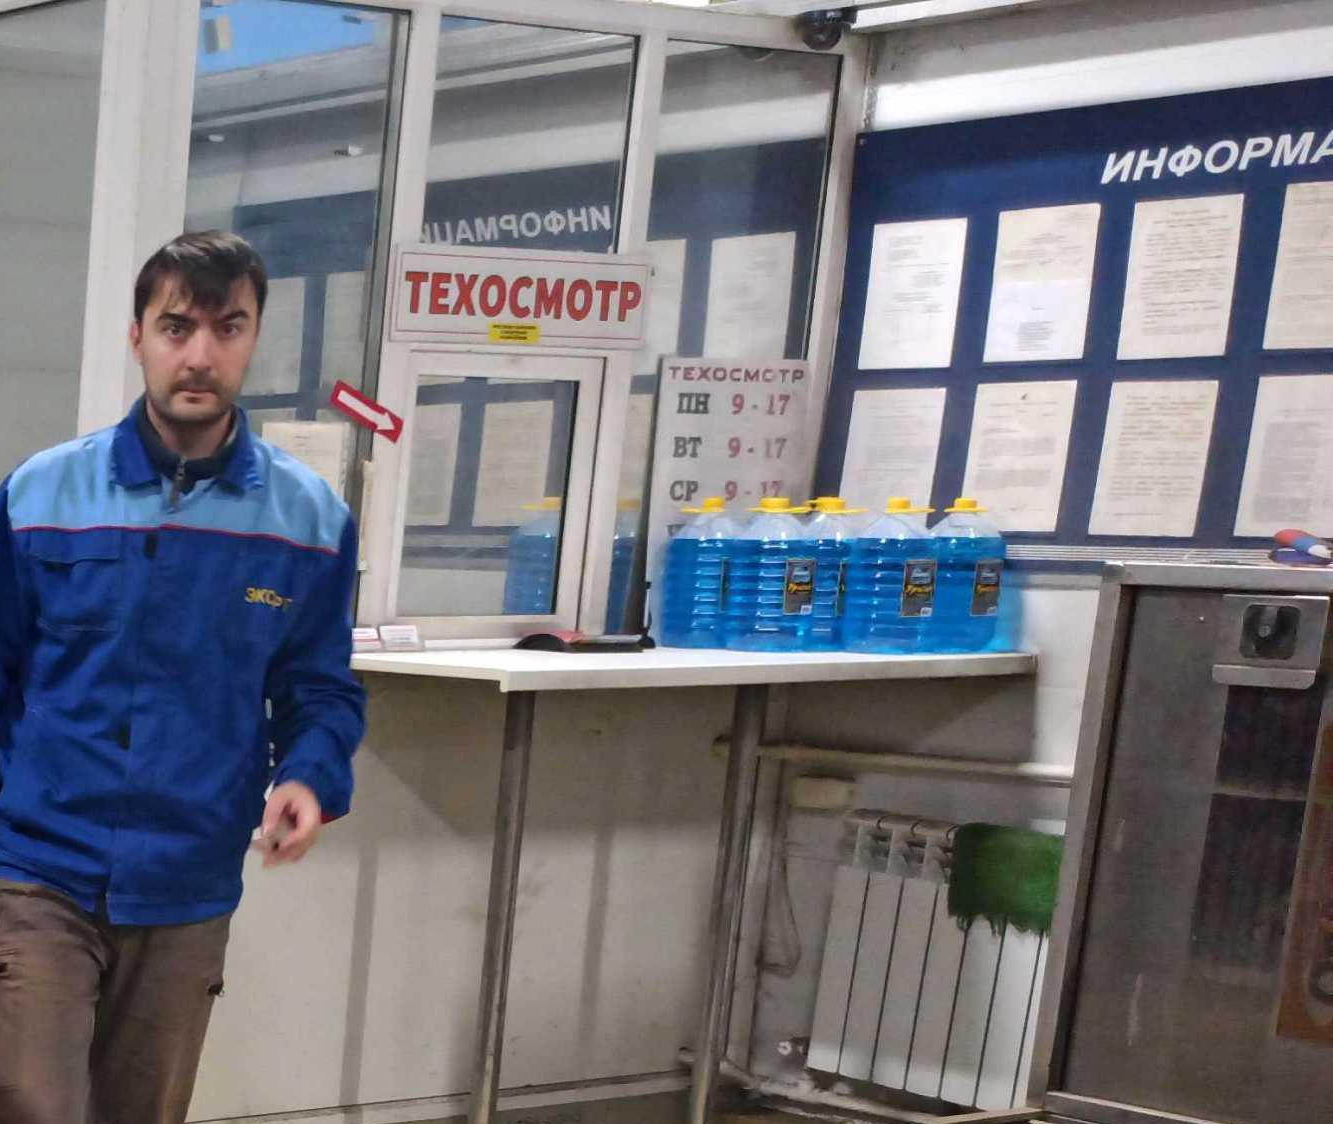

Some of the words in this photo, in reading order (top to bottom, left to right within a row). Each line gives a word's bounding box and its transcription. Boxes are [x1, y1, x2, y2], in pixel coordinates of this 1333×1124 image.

[404, 270, 642, 323] ТЕХОСМОТР
[669, 366, 805, 383] ТЕХОСМОТР
[677, 392, 711, 414] ПН
[733, 394, 744, 415] 9
[766, 394, 791, 415] 17
[673, 437, 702, 458] ВТ
[728, 437, 741, 458] 9
[765, 438, 787, 459] 17
[669, 480, 699, 501] СР
[724, 481, 738, 501] 9
